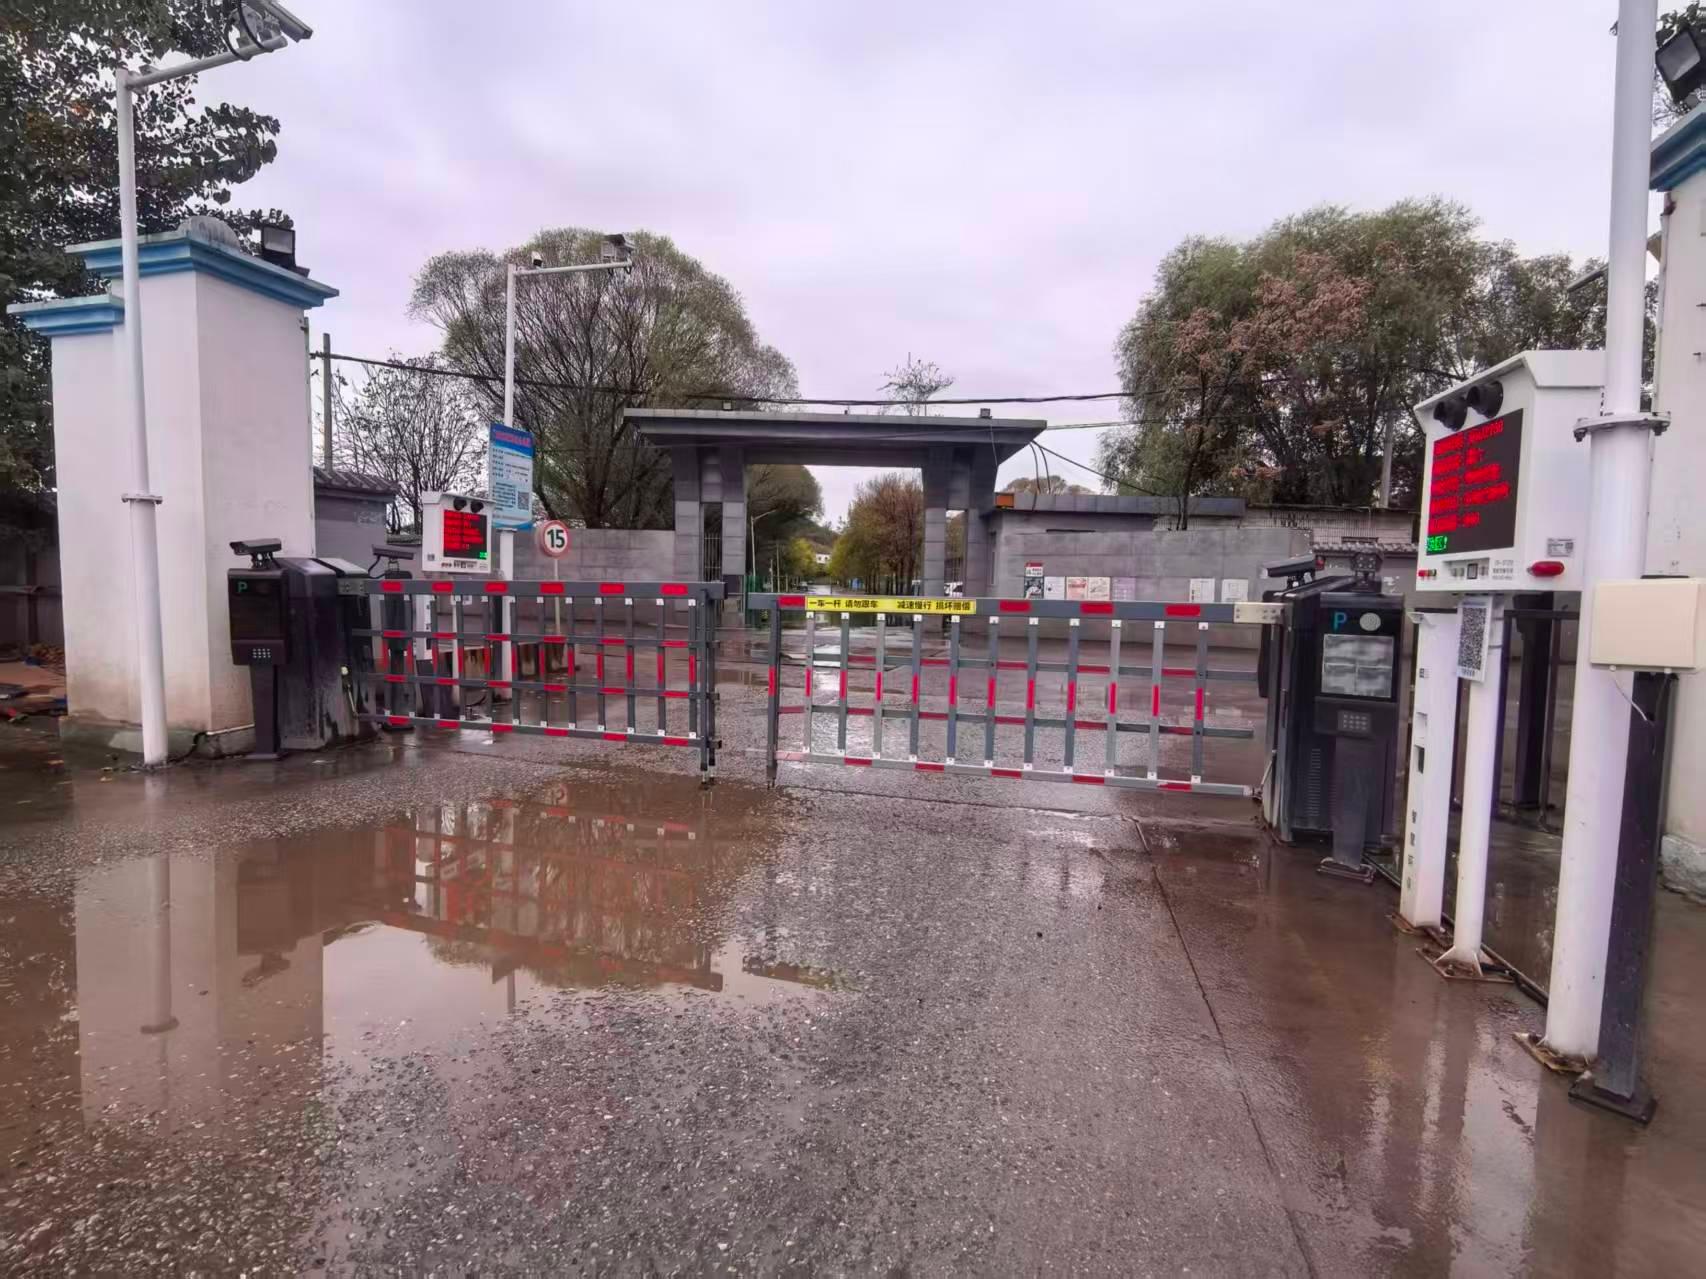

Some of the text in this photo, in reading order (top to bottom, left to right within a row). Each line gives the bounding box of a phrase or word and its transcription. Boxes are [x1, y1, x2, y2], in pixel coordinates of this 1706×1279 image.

[547, 529, 566, 549] 15
[238, 582, 248, 593] P
[809, 599, 971, 611] 一车一杆 请勿跟车 减速慢行 损坏赔偿
[1333, 612, 1348, 632] P
